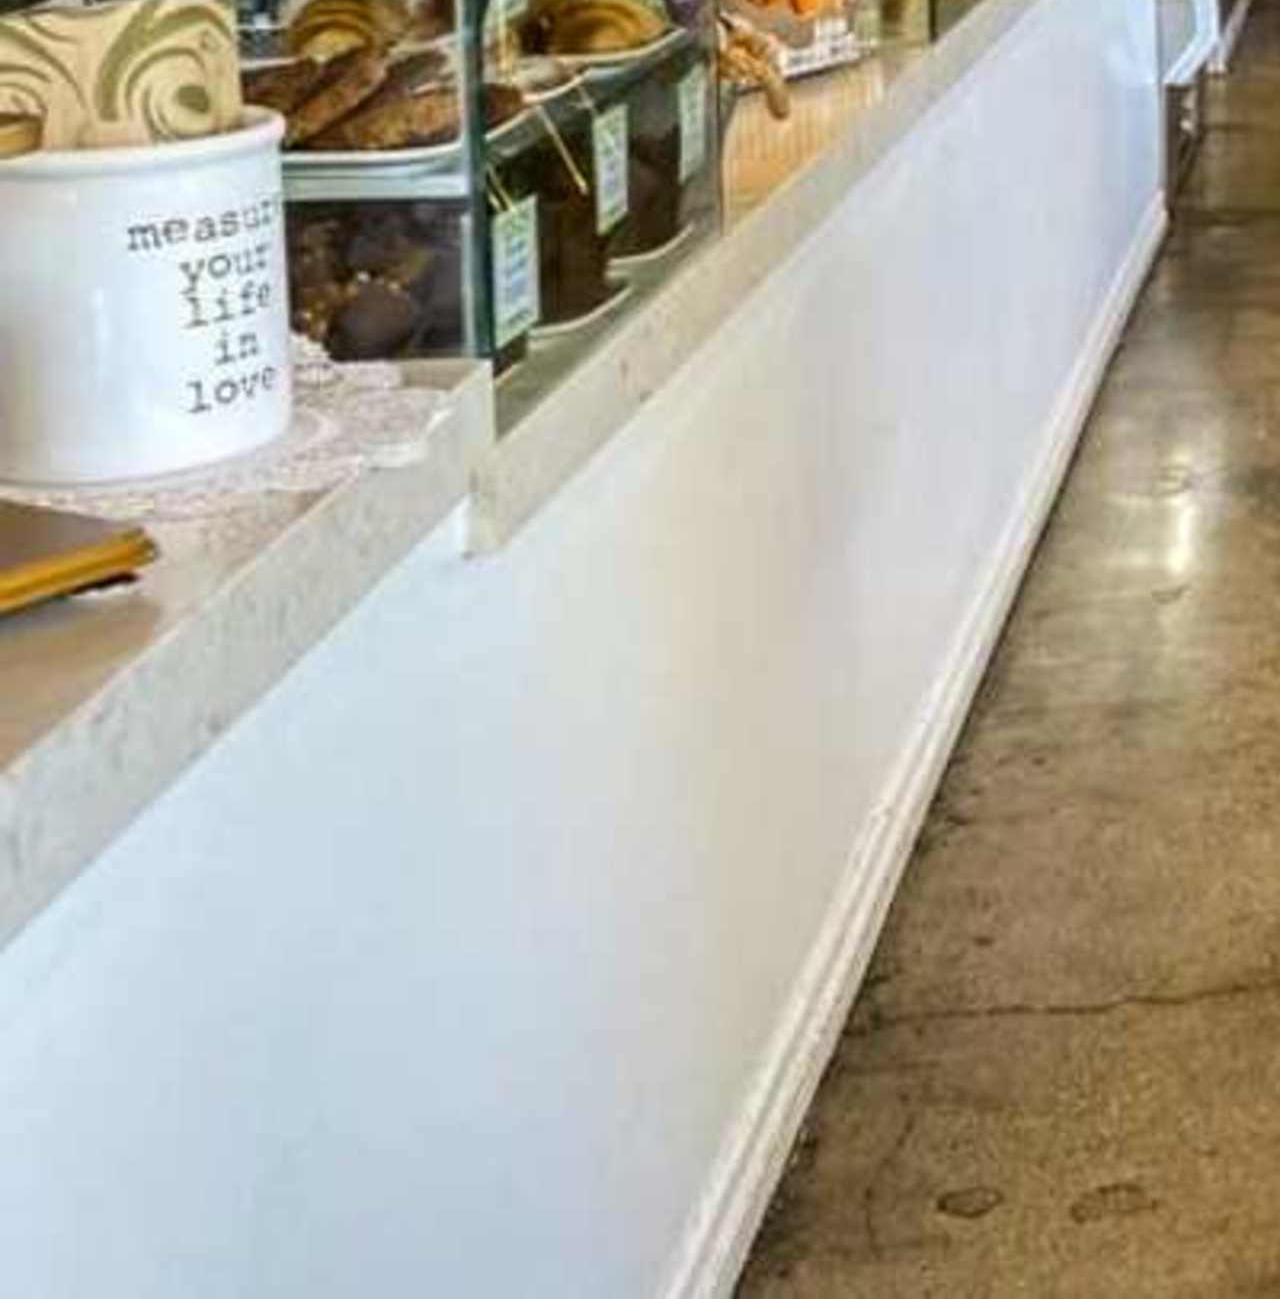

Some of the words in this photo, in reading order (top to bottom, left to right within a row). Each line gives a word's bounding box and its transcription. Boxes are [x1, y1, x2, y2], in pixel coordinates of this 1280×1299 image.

[178, 241, 270, 295] your
[183, 280, 271, 330] life
[214, 330, 260, 367] in
[185, 365, 276, 414] love
